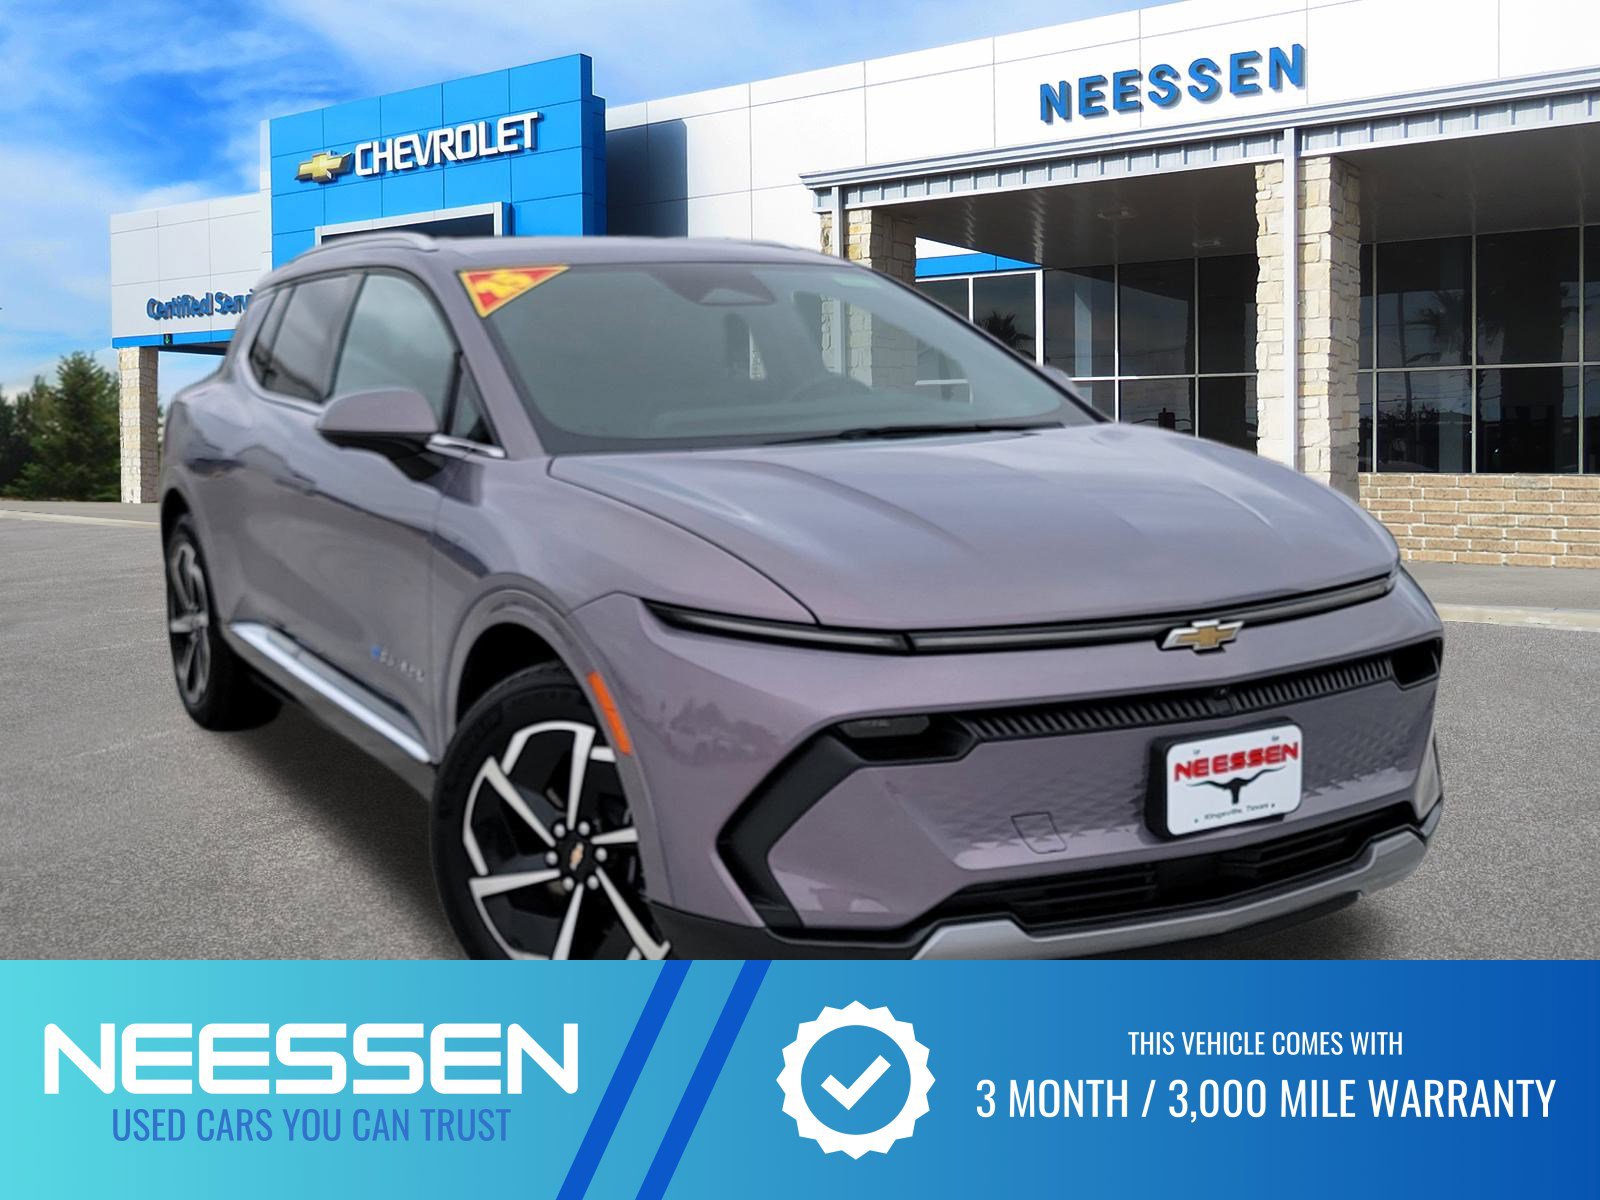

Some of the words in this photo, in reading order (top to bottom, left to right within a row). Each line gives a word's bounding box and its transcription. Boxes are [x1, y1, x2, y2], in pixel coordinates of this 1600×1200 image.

[1040, 43, 1307, 124] NEESSEN
[354, 111, 542, 178] CHEVROLET
[147, 294, 214, 320] Certified
[1174, 742, 1299, 782] NEESSEN
